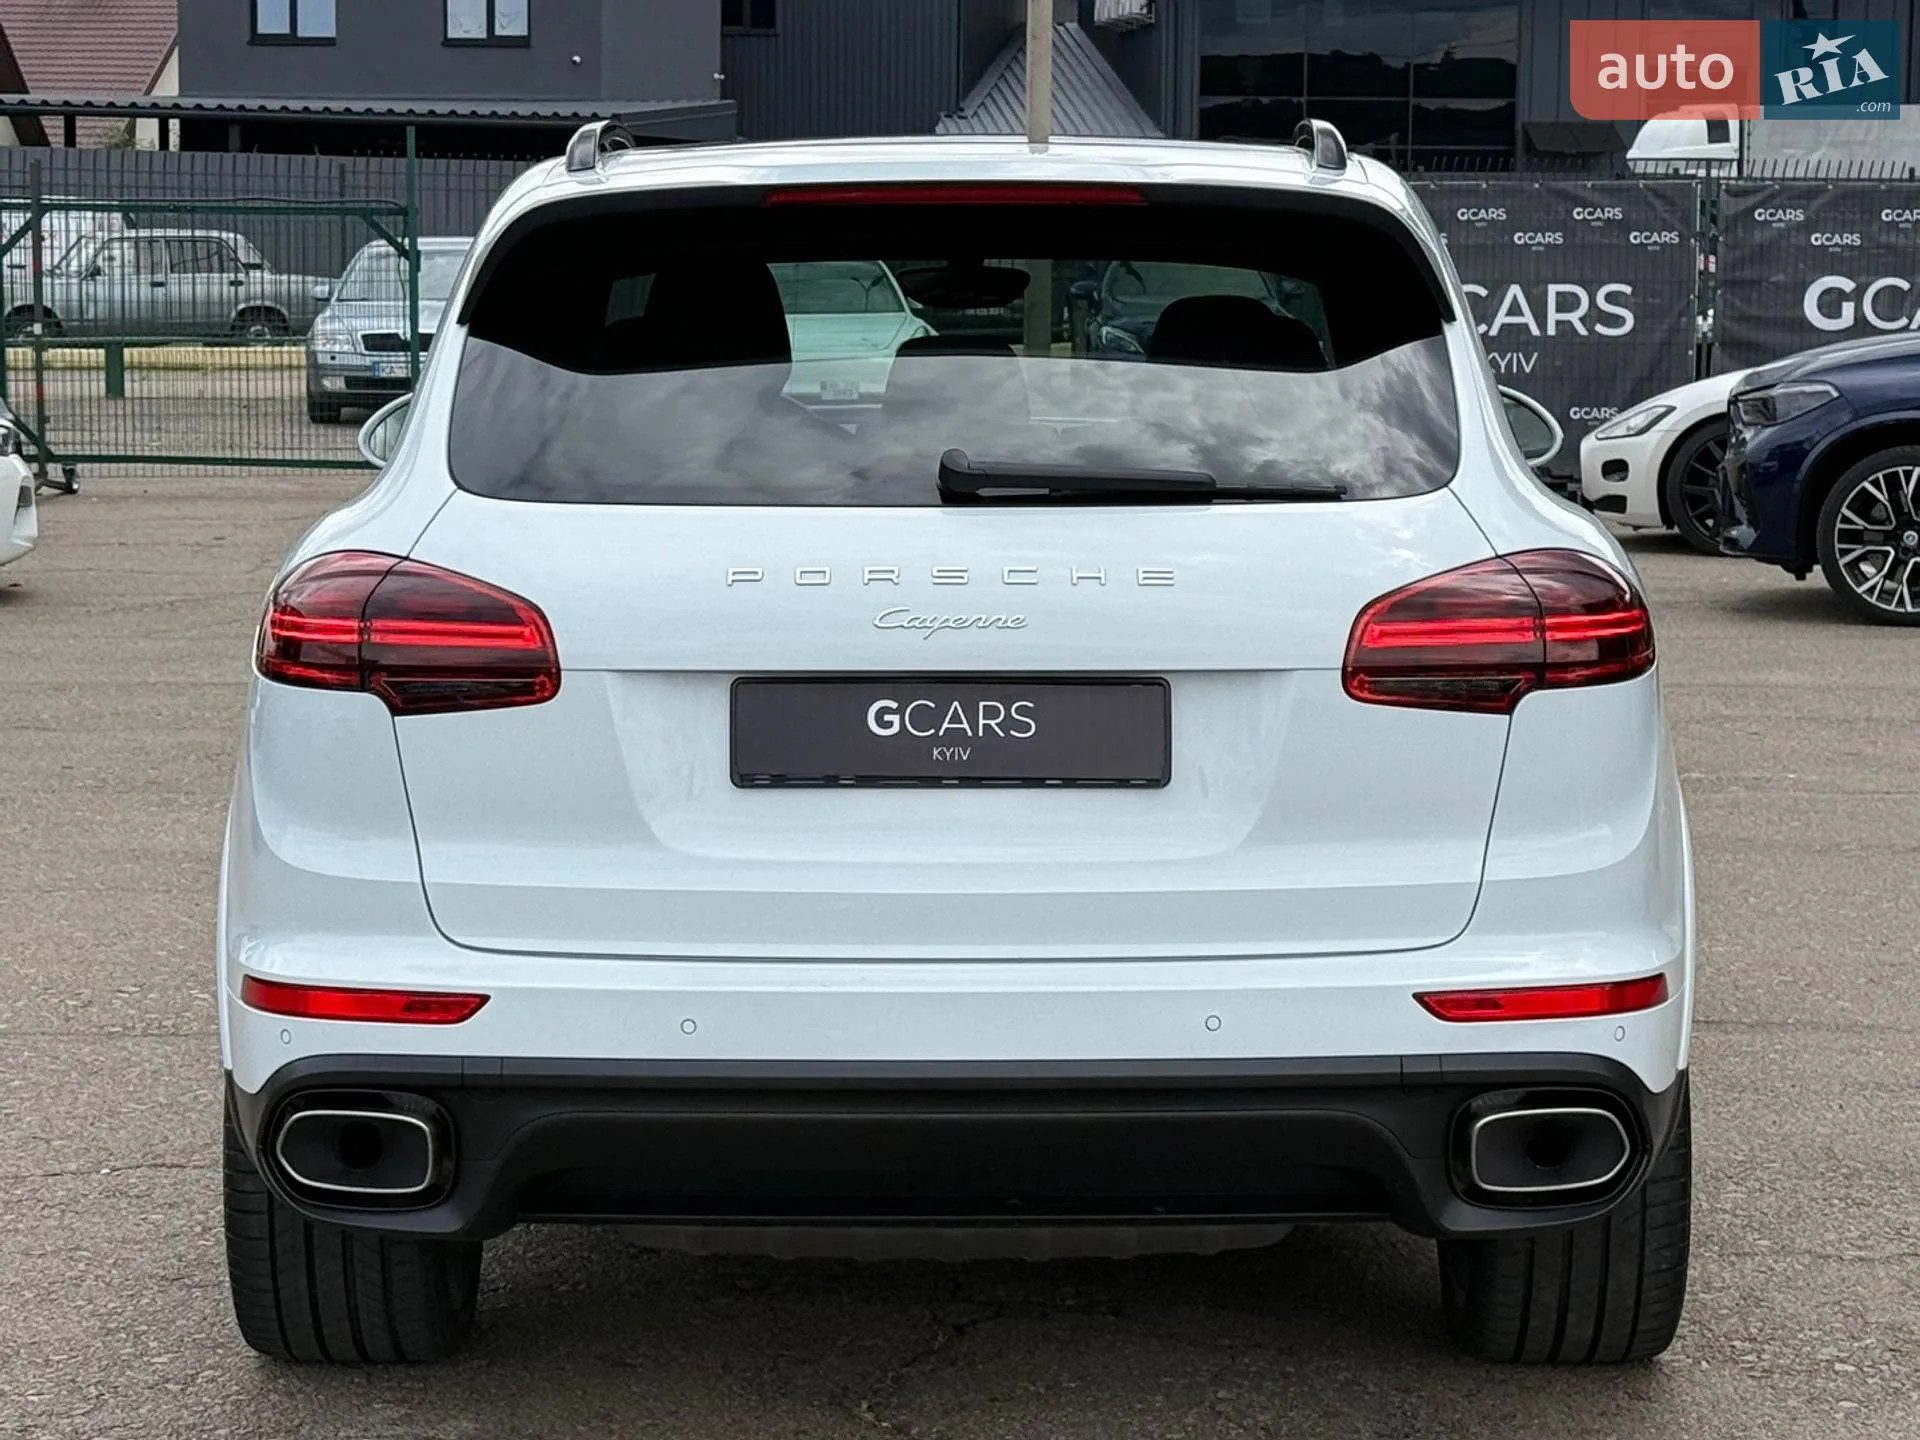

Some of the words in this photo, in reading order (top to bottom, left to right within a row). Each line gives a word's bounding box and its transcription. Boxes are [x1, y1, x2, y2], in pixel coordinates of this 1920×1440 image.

[1457, 208, 1507, 221] GCARS
[1573, 207, 1623, 220] GCARS
[1754, 208, 1805, 221] GCARS
[1513, 232, 1564, 245] GCARS
[1629, 231, 1680, 244] GCARS
[1811, 233, 1861, 246] GCARS
[1803, 275, 1920, 331] GC
[1569, 407, 1619, 420] GCARS
[726, 566, 1175, 586] PORSCHE
[873, 606, 1028, 640] Cayenne
[867, 699, 1036, 738] GCARS
[932, 746, 971, 761] KYIV
